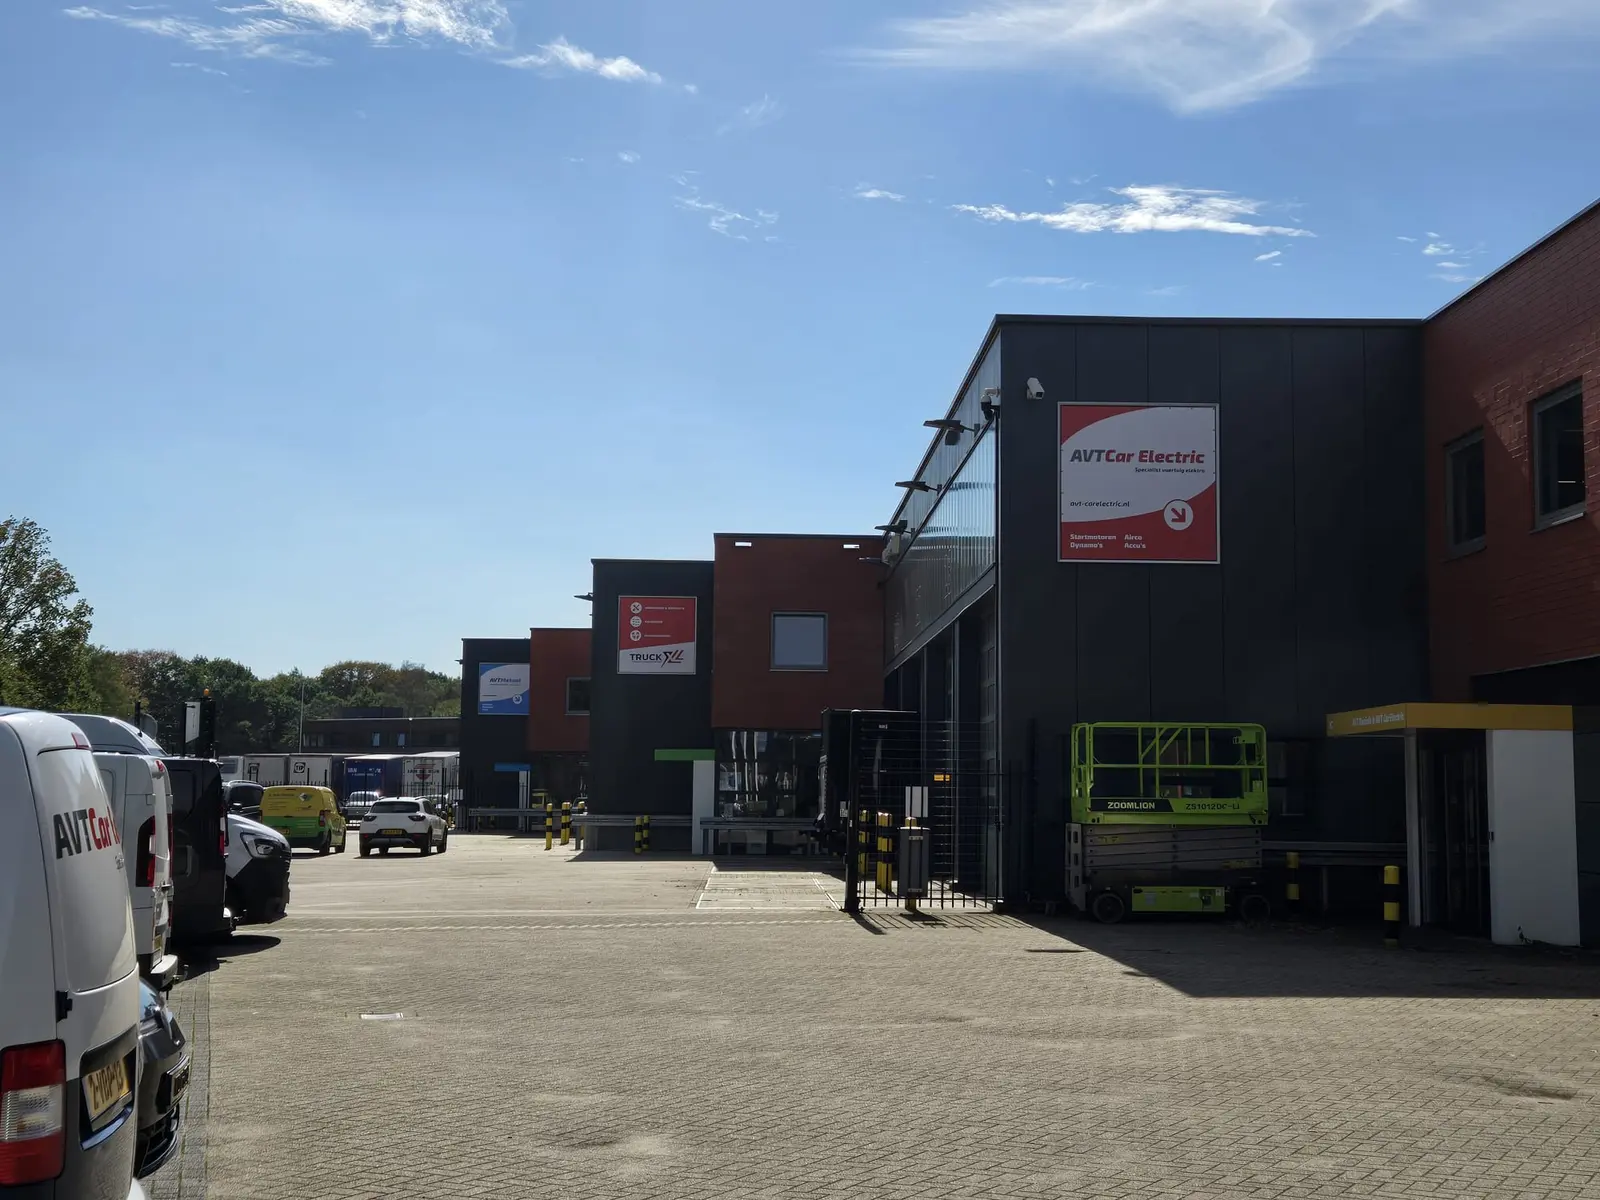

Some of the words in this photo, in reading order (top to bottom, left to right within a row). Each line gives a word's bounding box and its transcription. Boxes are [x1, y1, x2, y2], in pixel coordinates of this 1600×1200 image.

[1069, 449, 1135, 463] AVTCar
[1138, 450, 1205, 464] Electric
[1107, 801, 1156, 810] ZOOMLION
[52, 807, 112, 860] AVTCar
